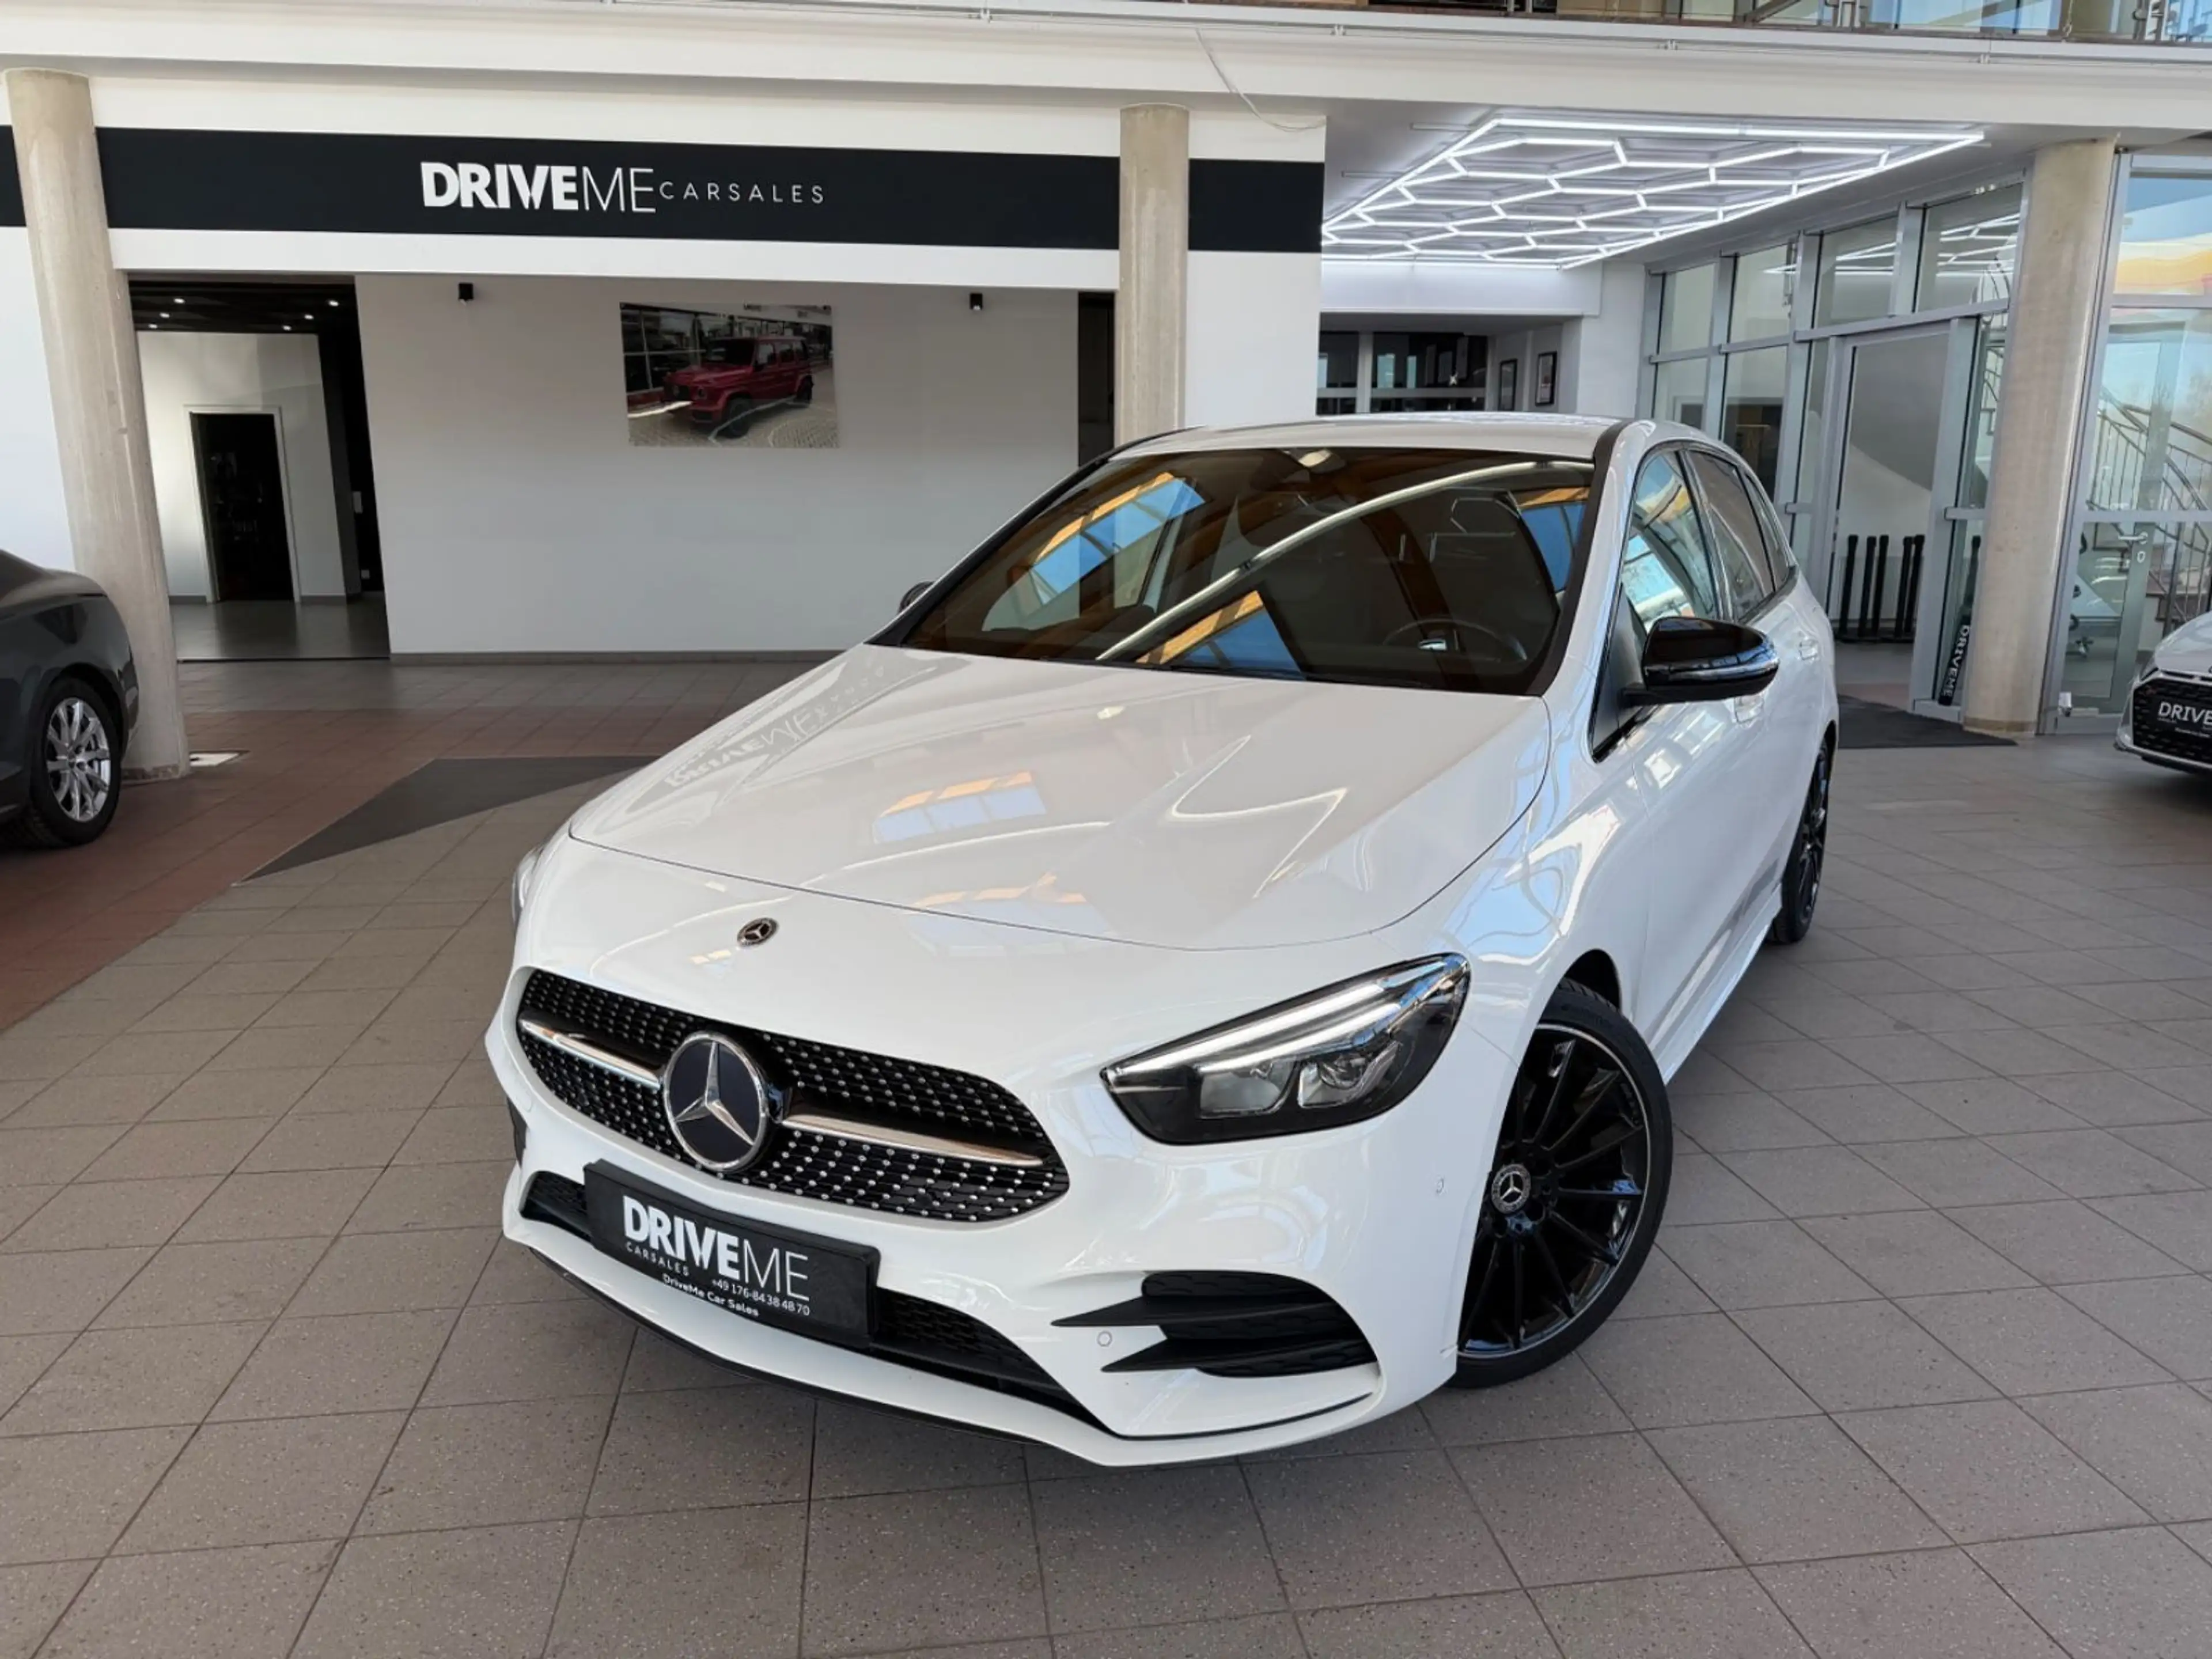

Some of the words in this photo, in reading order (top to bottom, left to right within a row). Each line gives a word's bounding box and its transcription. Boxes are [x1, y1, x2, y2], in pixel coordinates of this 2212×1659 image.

[421, 162, 656, 213] DRIVEME
[659, 181, 824, 204] CARSALES
[623, 1195, 809, 1302] DRIVEME
[626, 1241, 689, 1277] CARSALES
[663, 1273, 704, 1298] DriveMe
[707, 1291, 726, 1305] Car
[727, 1298, 759, 1317] Sales
[711, 1279, 729, 1291] +49
[797, 1304, 810, 1316] 70
